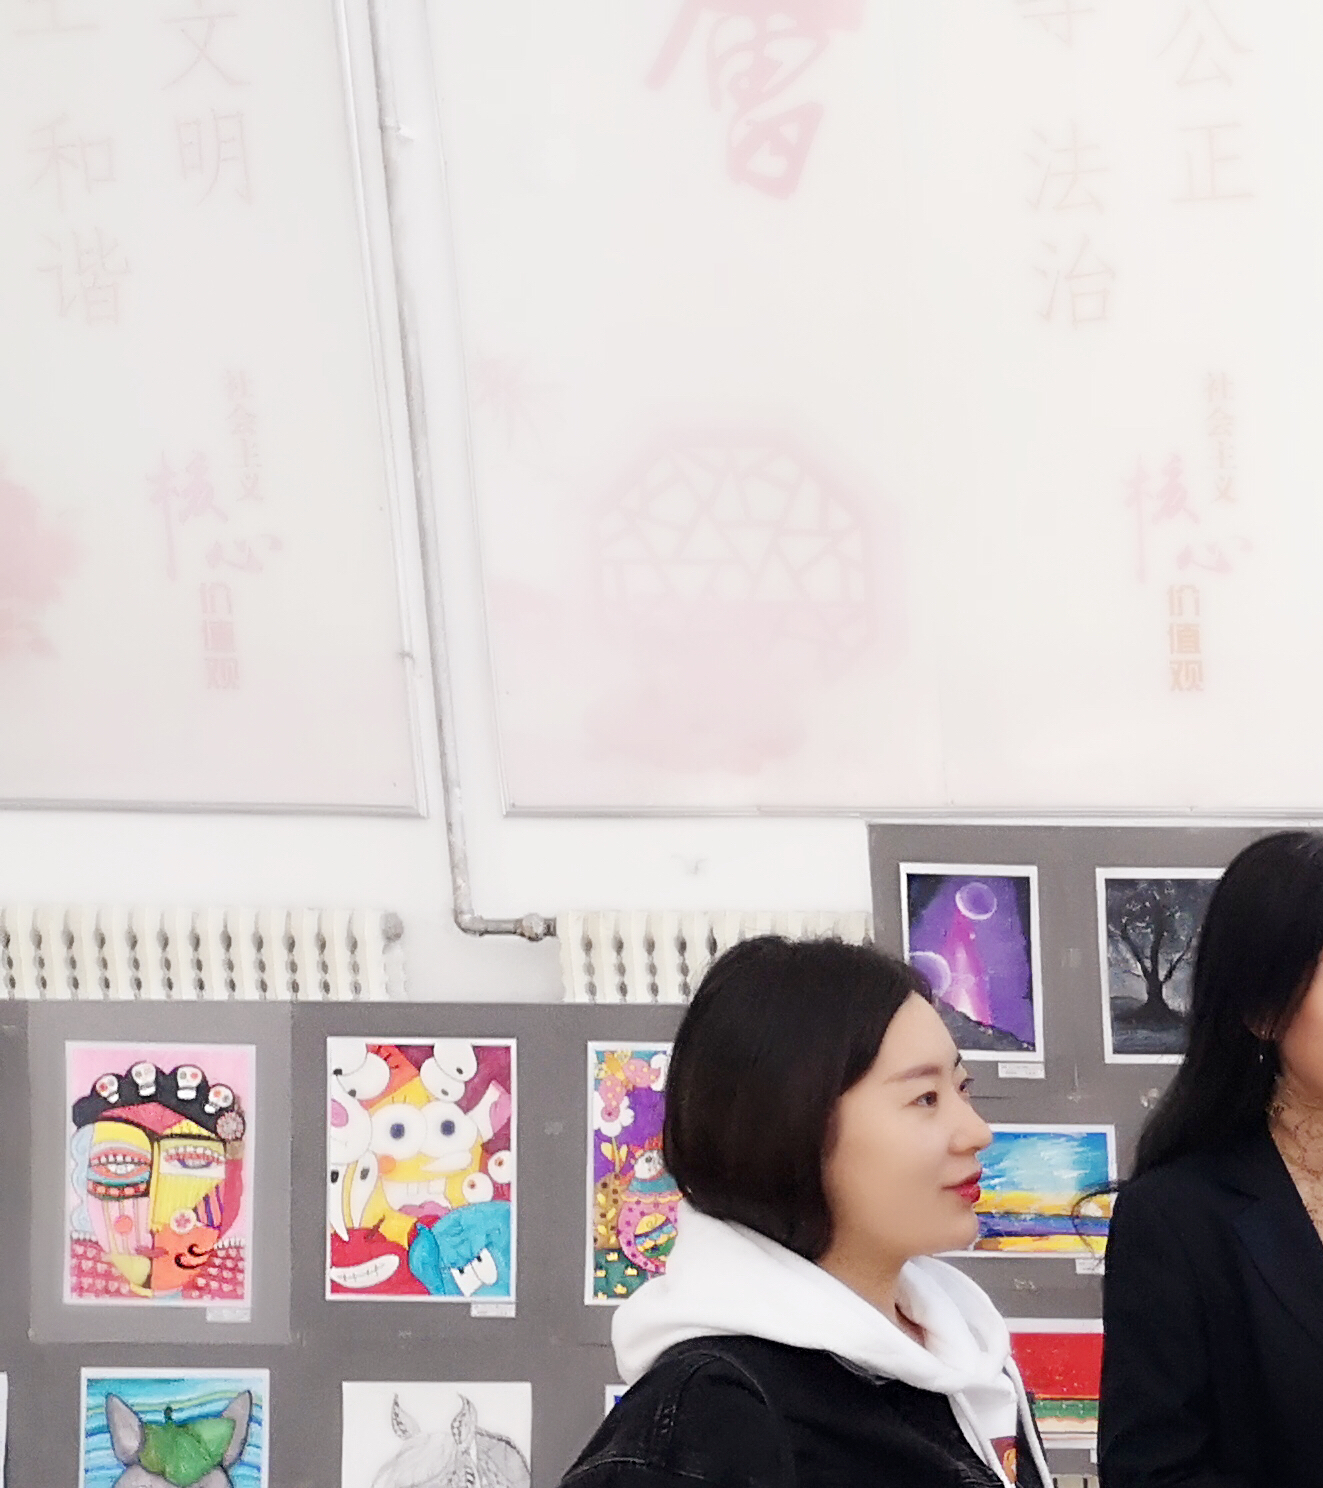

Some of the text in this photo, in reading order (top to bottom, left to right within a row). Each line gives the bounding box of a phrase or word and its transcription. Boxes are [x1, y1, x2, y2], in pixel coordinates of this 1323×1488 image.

[158, 0, 254, 206] 文明
[1156, 0, 1255, 204] 公正
[27, 111, 133, 326] 和谐
[1023, 118, 1118, 330] 法治
